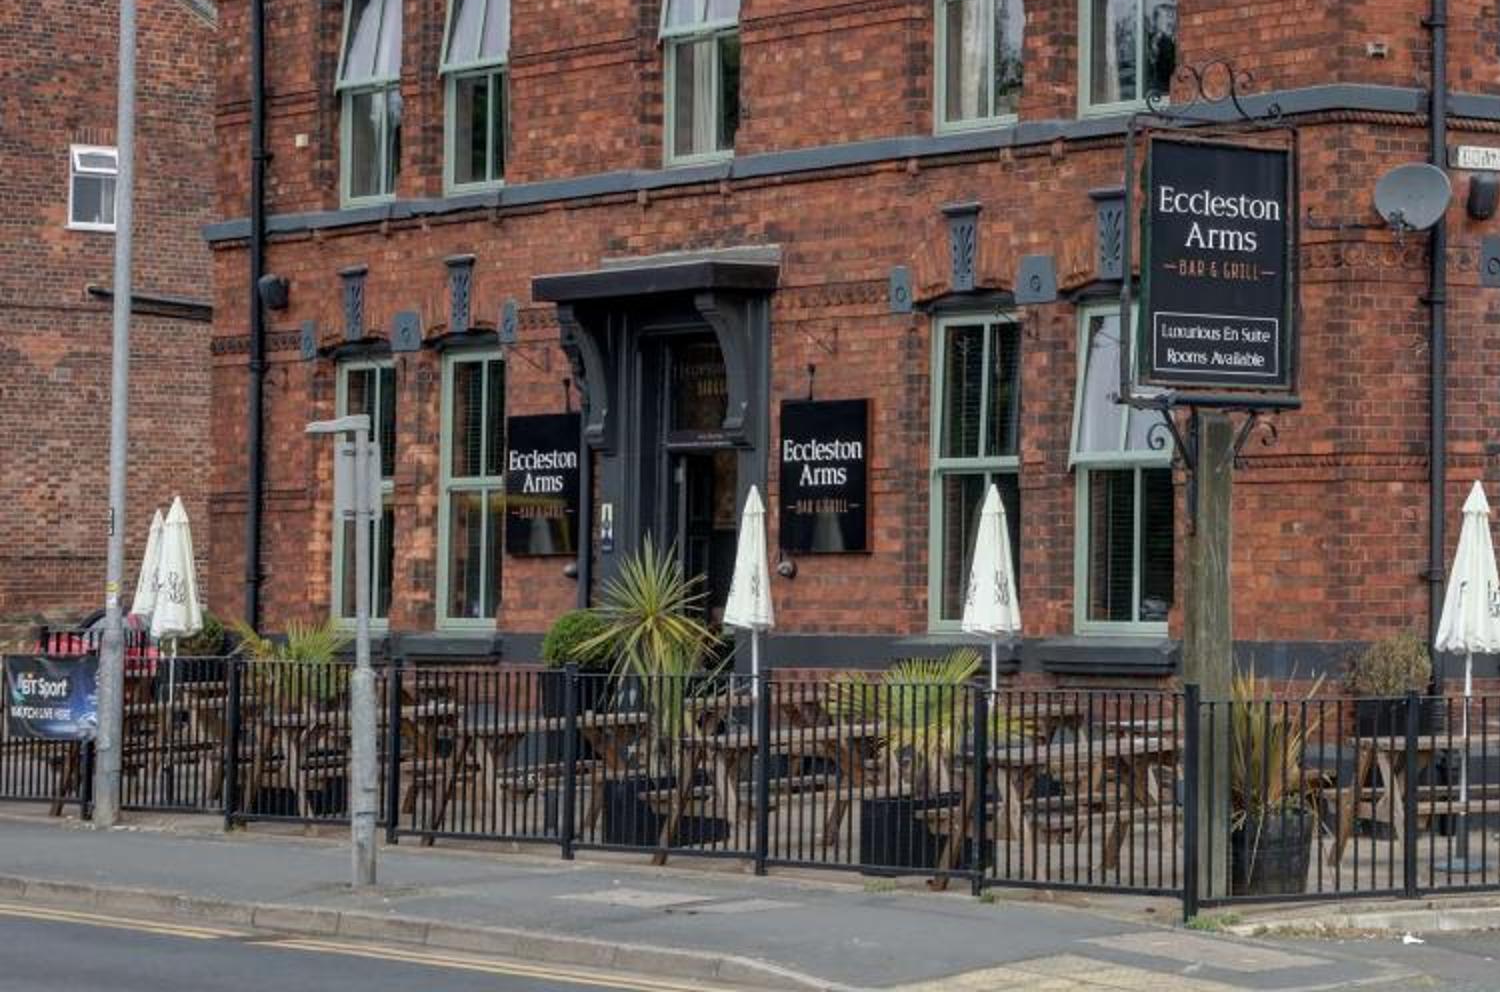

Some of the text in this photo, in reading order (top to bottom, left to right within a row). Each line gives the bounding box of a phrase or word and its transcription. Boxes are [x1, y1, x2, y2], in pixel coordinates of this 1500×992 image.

[1158, 185, 1281, 221] Eccleston
[1184, 221, 1258, 253] Arms
[1178, 259, 1261, 281] BAR & GRILL
[1161, 323, 1272, 343] Luxurious En Suite
[1167, 348, 1265, 367] Rooms Available
[508, 449, 578, 471] Eccleston
[783, 438, 863, 462] Eccleston
[522, 472, 564, 494] Arms
[799, 463, 848, 487] Arms
[22, 677, 68, 699] BT Sport
